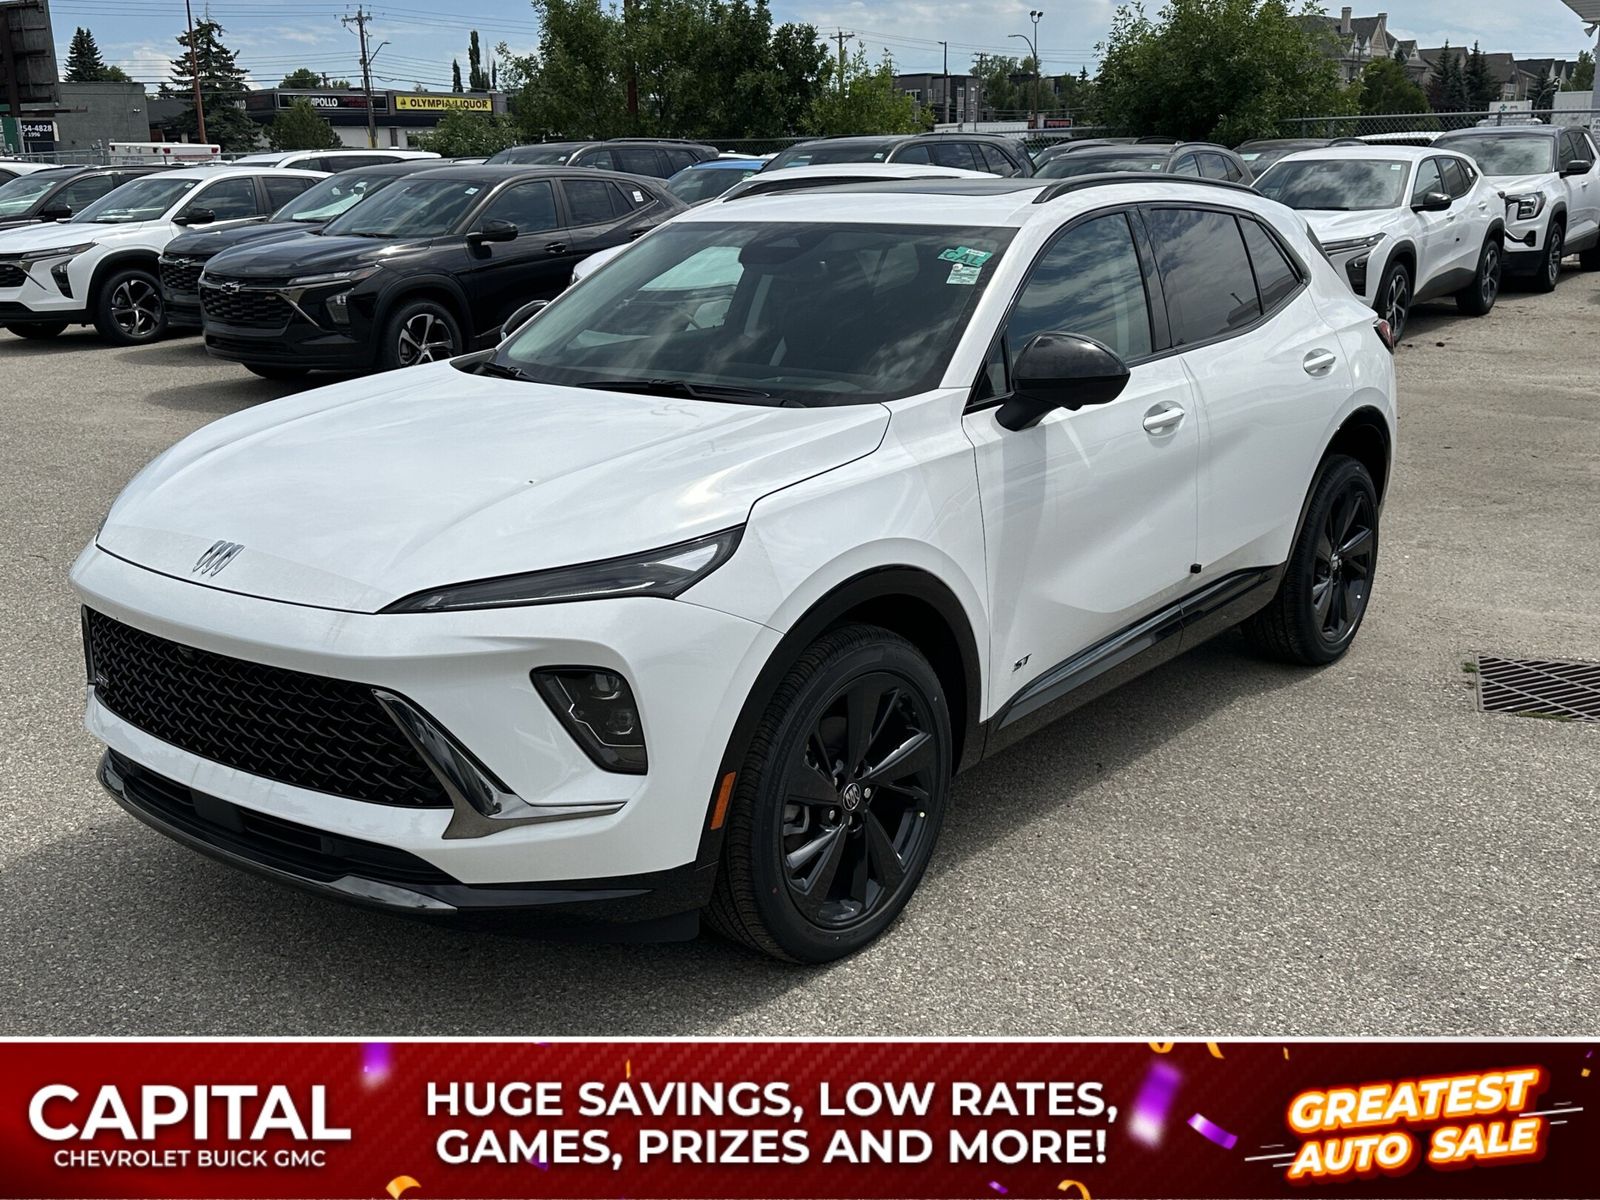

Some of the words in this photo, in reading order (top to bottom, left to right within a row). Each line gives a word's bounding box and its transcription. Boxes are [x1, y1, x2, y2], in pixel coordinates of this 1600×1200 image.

[311, 98, 338, 107] APOLLO
[410, 98, 451, 108] OLYMPIA
[455, 100, 488, 109] LIQUOR
[21, 124, 53, 132] 54-4828
[1012, 653, 1032, 673] ST
